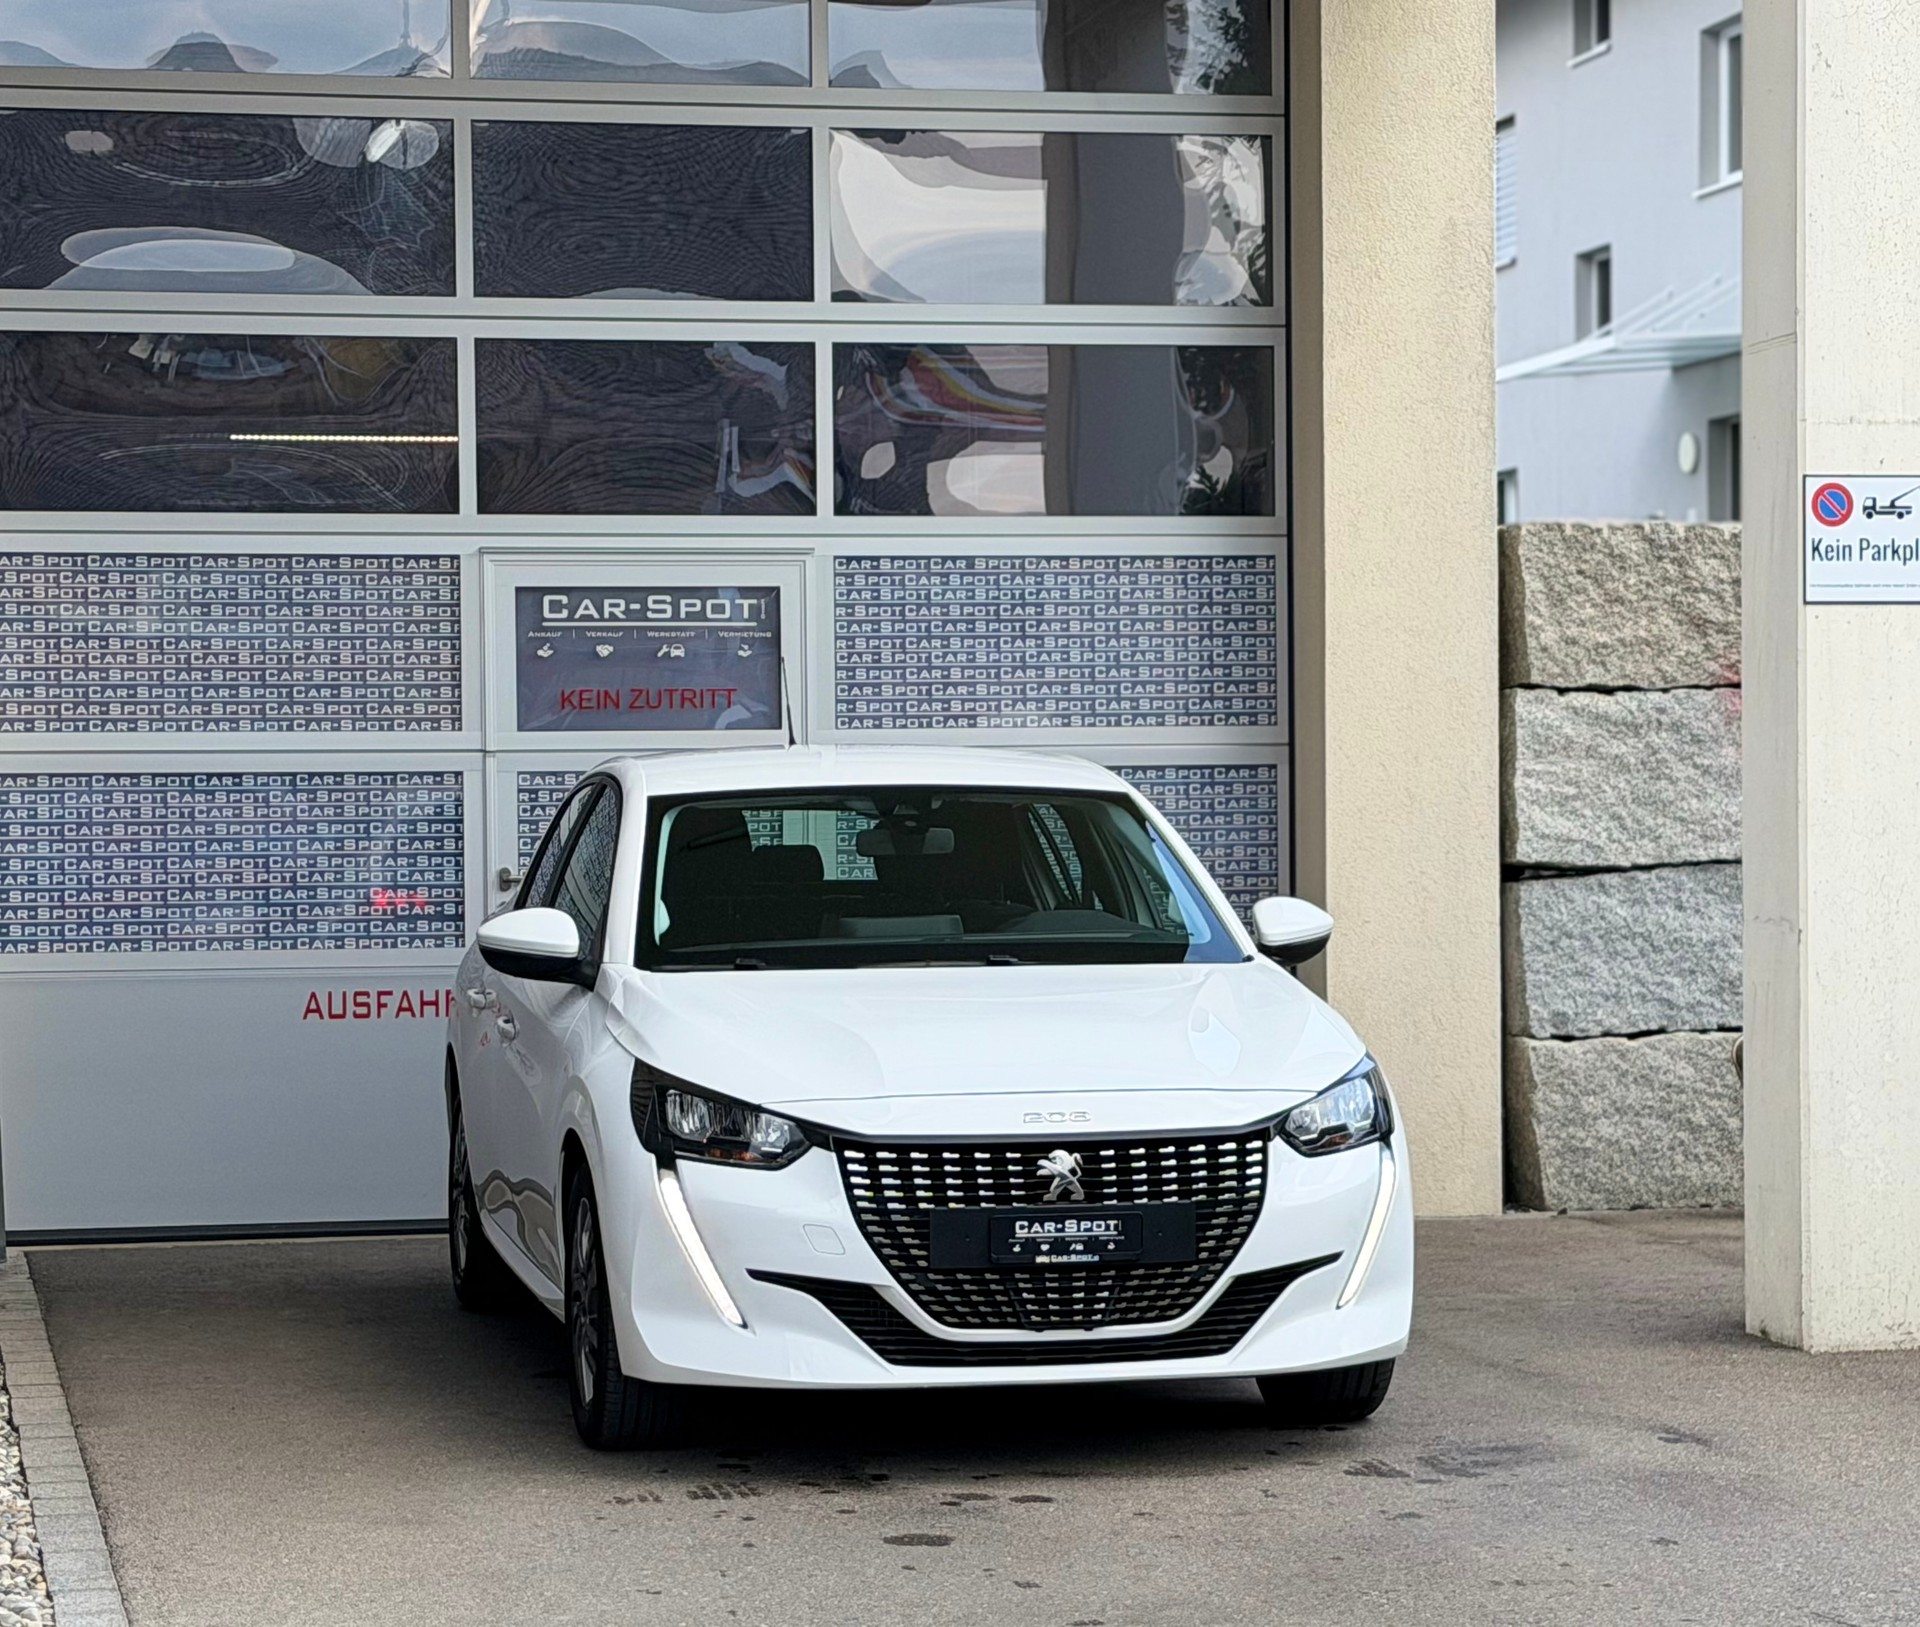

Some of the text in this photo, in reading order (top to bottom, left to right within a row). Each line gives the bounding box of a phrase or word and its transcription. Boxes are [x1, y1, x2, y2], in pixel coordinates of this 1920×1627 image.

[1811, 537, 1919, 567] Kein Parkpl
[0, 555, 390, 568] AR-SPOT CAR-SPOT CAR-SPOT CAR-SPOT
[835, 558, 927, 569] CAR-SPOT
[1024, 557, 1116, 569] CAR-SPOT
[1118, 557, 1210, 568] CAR-SPOT
[60, 572, 159, 584] CAR-SPOT
[162, 572, 262, 584] CAR-SPOT
[264, 573, 363, 585] CAR-SPOT
[904, 574, 997, 585] CAR-SPOT
[999, 574, 1091, 585] CAR-SPOT
[1093, 573, 1185, 584] CAR-SPOT
[0, 587, 391, 600] AR-SPOT CAR-SPOT CAR-SPOT CAR-SPOT
[835, 588, 1211, 600] CAR-SPOT CAR-SPOT CAR-SPOT CAR-SPOT
[60, 604, 160, 616] CAR-SPOT
[162, 604, 262, 616] CAR-SPOT
[264, 604, 364, 616] CAR-SPOT
[542, 595, 757, 619] CAR-SPOT
[904, 604, 997, 616] CAR-SPOT
[999, 604, 1091, 616] CAR-SPOT
[0, 621, 391, 633] AR-SPOT CAR-SPOT CAR-SPOT CAR-SPOT
[836, 620, 1211, 632] CAR-SPOT CAR-SPOT CAR-SPOT CAR-SPOT
[60, 637, 160, 649] CAR-SPOT
[163, 638, 262, 650] CAR-SPOT
[264, 638, 364, 650] CAR-SPOT
[905, 637, 997, 648] CAR-SPOT
[999, 636, 1092, 648] CAR-SPOT
[1093, 636, 1186, 647] CAR-SPOT
[0, 652, 391, 664] AR-SPOT CAR-SPOT CAR-SPOT CAR-SPOT
[836, 650, 1211, 663] CAR-SPOT CAR-SPOT CAR-SPOT CAR-SPOT
[61, 669, 160, 681] CAR-SPOT
[163, 669, 262, 681] CAR-SPOT
[265, 669, 364, 681] CAR-SPOT
[905, 667, 998, 679] CAR-SPOT
[999, 667, 1092, 678] CAR-SPOT
[1094, 666, 1186, 677] CAR-SPOT
[0, 686, 392, 698] AR-SPOT CAR-SPOT CAR-SPOT CAR-SPOT
[836, 682, 1212, 696] CAR-SPOT CAR-SPOT CAR-SPOT CAR-SPOT
[560, 688, 737, 710] KEIN ZUTRITT
[906, 700, 998, 712] CAR-SPOT
[1000, 699, 1092, 711] CAR-SPOT
[1094, 698, 1187, 710] CAR-SPOT
[61, 703, 160, 715] CAR-SPOT
[163, 703, 262, 715] CAR-SPOT
[265, 703, 364, 715] CAR-SPOT
[0, 719, 392, 732] AR-SPOT CAR-SPOT CAR-SPOT CAR-SPOT
[837, 714, 1212, 728] CAR-SPOT CAR-SPOT CAR-SPOT CAR-SPOT
[1121, 768, 1212, 780] CAR-SPOT
[0, 774, 395, 788] AR-SPOT CAR-SPOT CAR-SPOT CAR-SPOT
[64, 792, 164, 804] CAR-SPOT
[166, 792, 266, 803] CAR-SPOT
[268, 791, 368, 802] CAR-SPOT
[0, 805, 395, 819] AR-SPOT CAR-SPOT CAR-SPOT CAR-SPOT
[64, 824, 164, 836] CAR-SPOT
[166, 824, 266, 835] CAR-SPOT
[268, 822, 368, 834] CAR-SPOT
[0, 839, 395, 853] AR-SPOT CAR-SPOT CAR-SPOT CAR-SPOT
[64, 858, 164, 870] CAR-SPOT
[166, 857, 266, 869] CAR-SPOT
[268, 856, 368, 868] CAR-SPOT
[0, 870, 395, 885] AR-SPOT CAR-SPOT CAR-SPOT CAR-SPOT
[64, 890, 164, 902] CAR-SPOT
[166, 889, 266, 901] CAR-SPOT
[268, 888, 368, 899] CAR-SPOT
[0, 904, 395, 920] AR-SPOT CAR-SPOT CAR-SPOT CAR-SPOT
[64, 924, 164, 935] CAR-SPOT
[166, 922, 266, 934] CAR-SPOT
[268, 921, 368, 933] CAR-SPOT
[0, 938, 396, 953] AR-SPOT CAR-SPOT CAR-SPOT CAR-SPOT
[1015, 1219, 1118, 1234] CAR-SPOT
